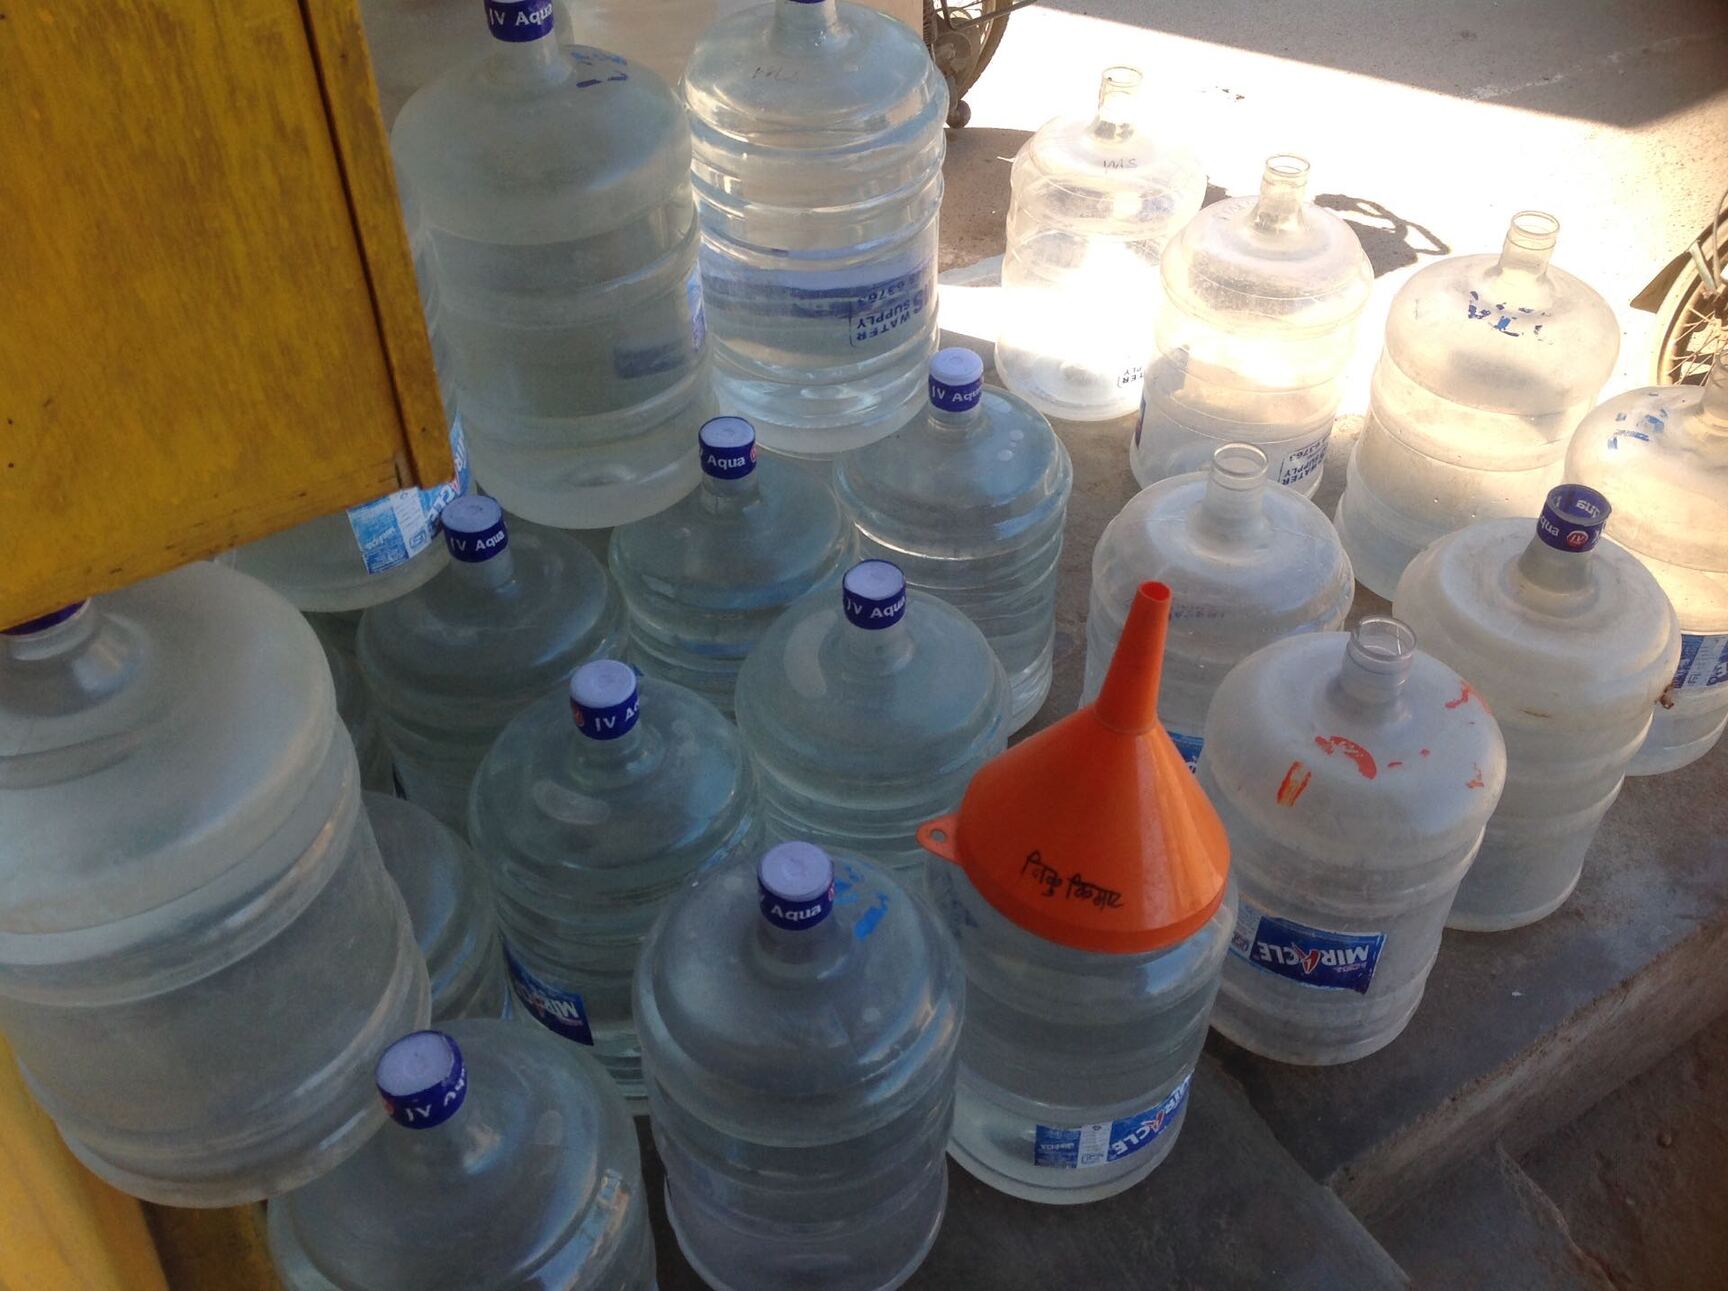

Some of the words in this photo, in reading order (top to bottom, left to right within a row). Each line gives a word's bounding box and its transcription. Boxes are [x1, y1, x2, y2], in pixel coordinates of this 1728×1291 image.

[515, 3, 553, 26] Aqua
[857, 300, 911, 329] SUPPLY
[857, 311, 911, 341] WATER
[707, 454, 746, 470] Aqua
[475, 530, 505, 552] Aqua
[771, 904, 822, 922] Aqua
[1257, 942, 1370, 975] MIRACLE
